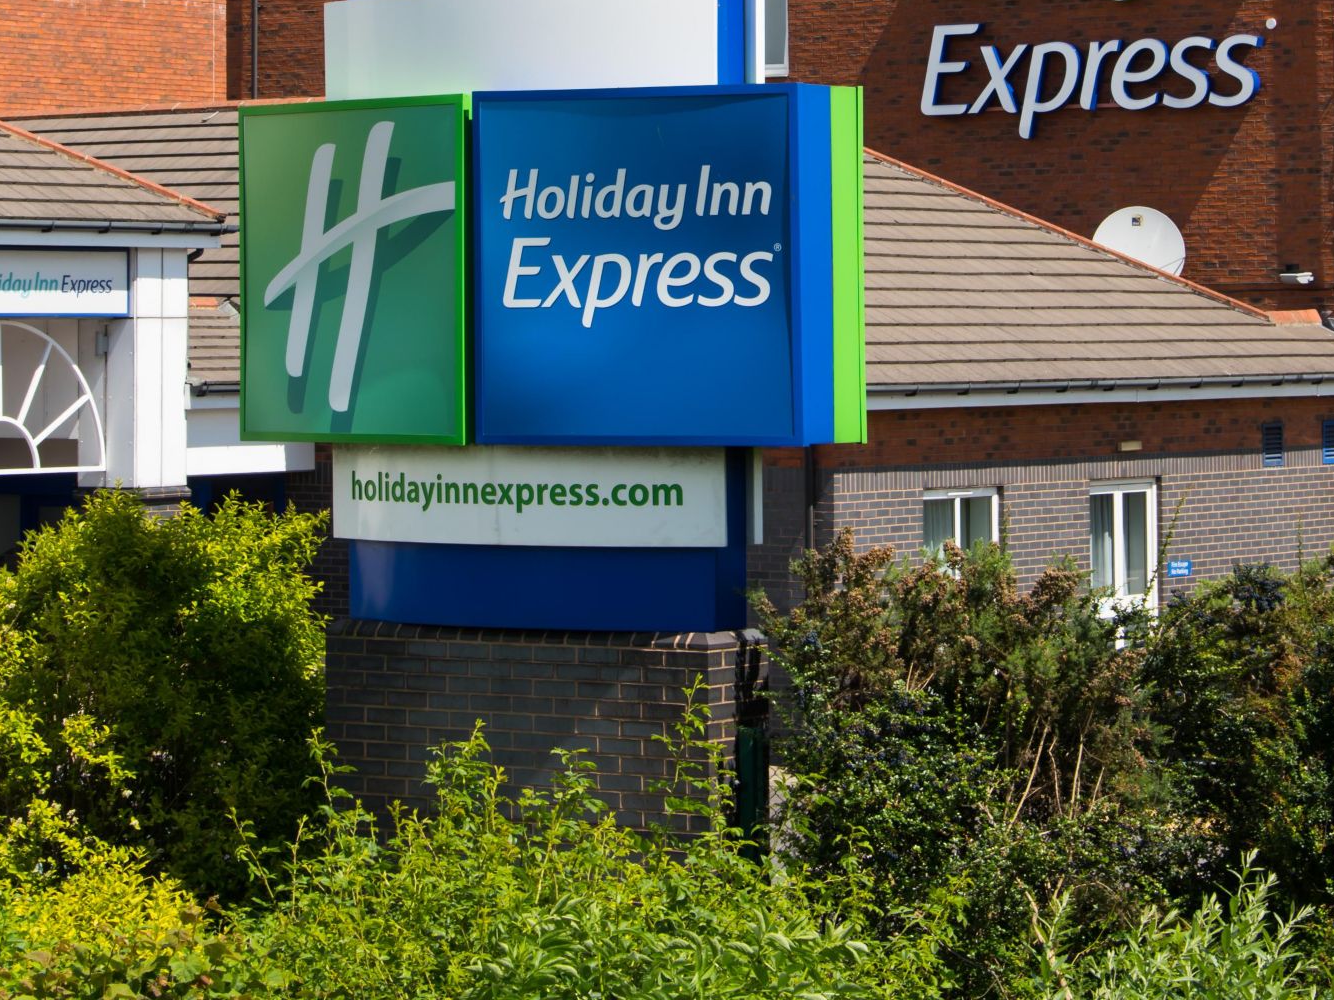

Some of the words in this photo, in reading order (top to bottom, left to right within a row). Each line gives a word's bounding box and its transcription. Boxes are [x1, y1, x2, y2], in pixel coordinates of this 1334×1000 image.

[921, 22, 1264, 140] Express
[500, 168, 687, 231] Holiday
[695, 164, 772, 217] Inn
[34, 272, 58, 292] Inn
[62, 275, 113, 298] Express
[351, 471, 684, 513] holidayinnexpress.com
